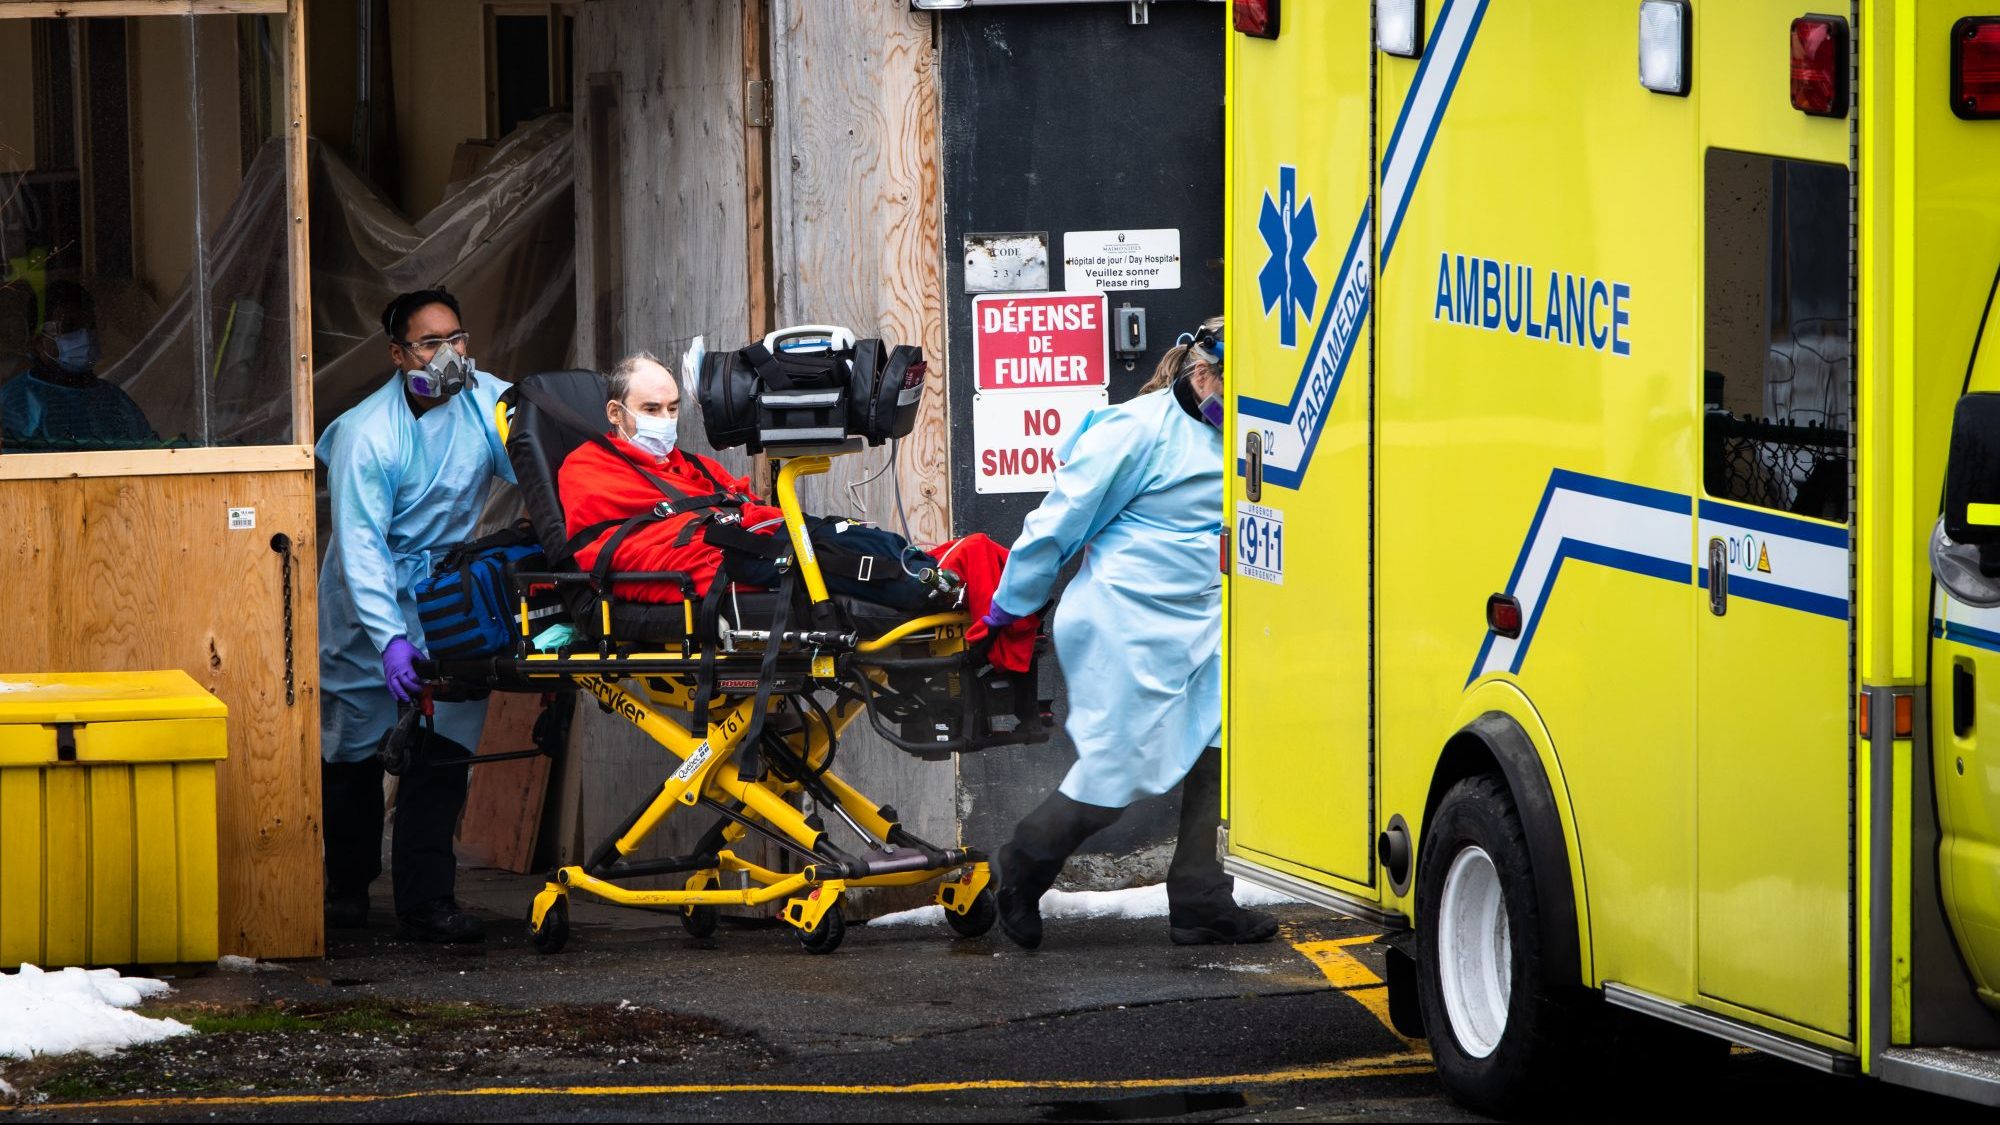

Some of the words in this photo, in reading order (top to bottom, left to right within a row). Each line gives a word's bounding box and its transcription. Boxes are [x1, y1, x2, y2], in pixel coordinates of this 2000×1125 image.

[992, 248, 1022, 257] CODE
[1097, 256, 1106, 265] de
[1107, 255, 1123, 267] jour
[1129, 255, 1143, 266] Day
[1144, 254, 1176, 265] Hospital
[1085, 268, 1123, 278] Veuillez
[1126, 268, 1160, 277] sonner
[1096, 279, 1128, 288] Please
[1130, 278, 1150, 289] ring
[1434, 252, 1631, 356] AMBULANCE
[984, 301, 1097, 334] DÉFENSE
[1028, 335, 1053, 354] DE
[1297, 259, 1368, 446] PARAMÉDIC
[995, 355, 1088, 385] FUMER
[1024, 408, 1061, 437] NO
[1264, 430, 1275, 456] D2
[982, 447, 1065, 477] SMOK
[1248, 504, 1273, 518] URGENCE
[1729, 536, 1741, 565] D1
[1244, 566, 1276, 582] EMERGENCY
[935, 622, 964, 640] 761
[720, 709, 744, 740] 761
